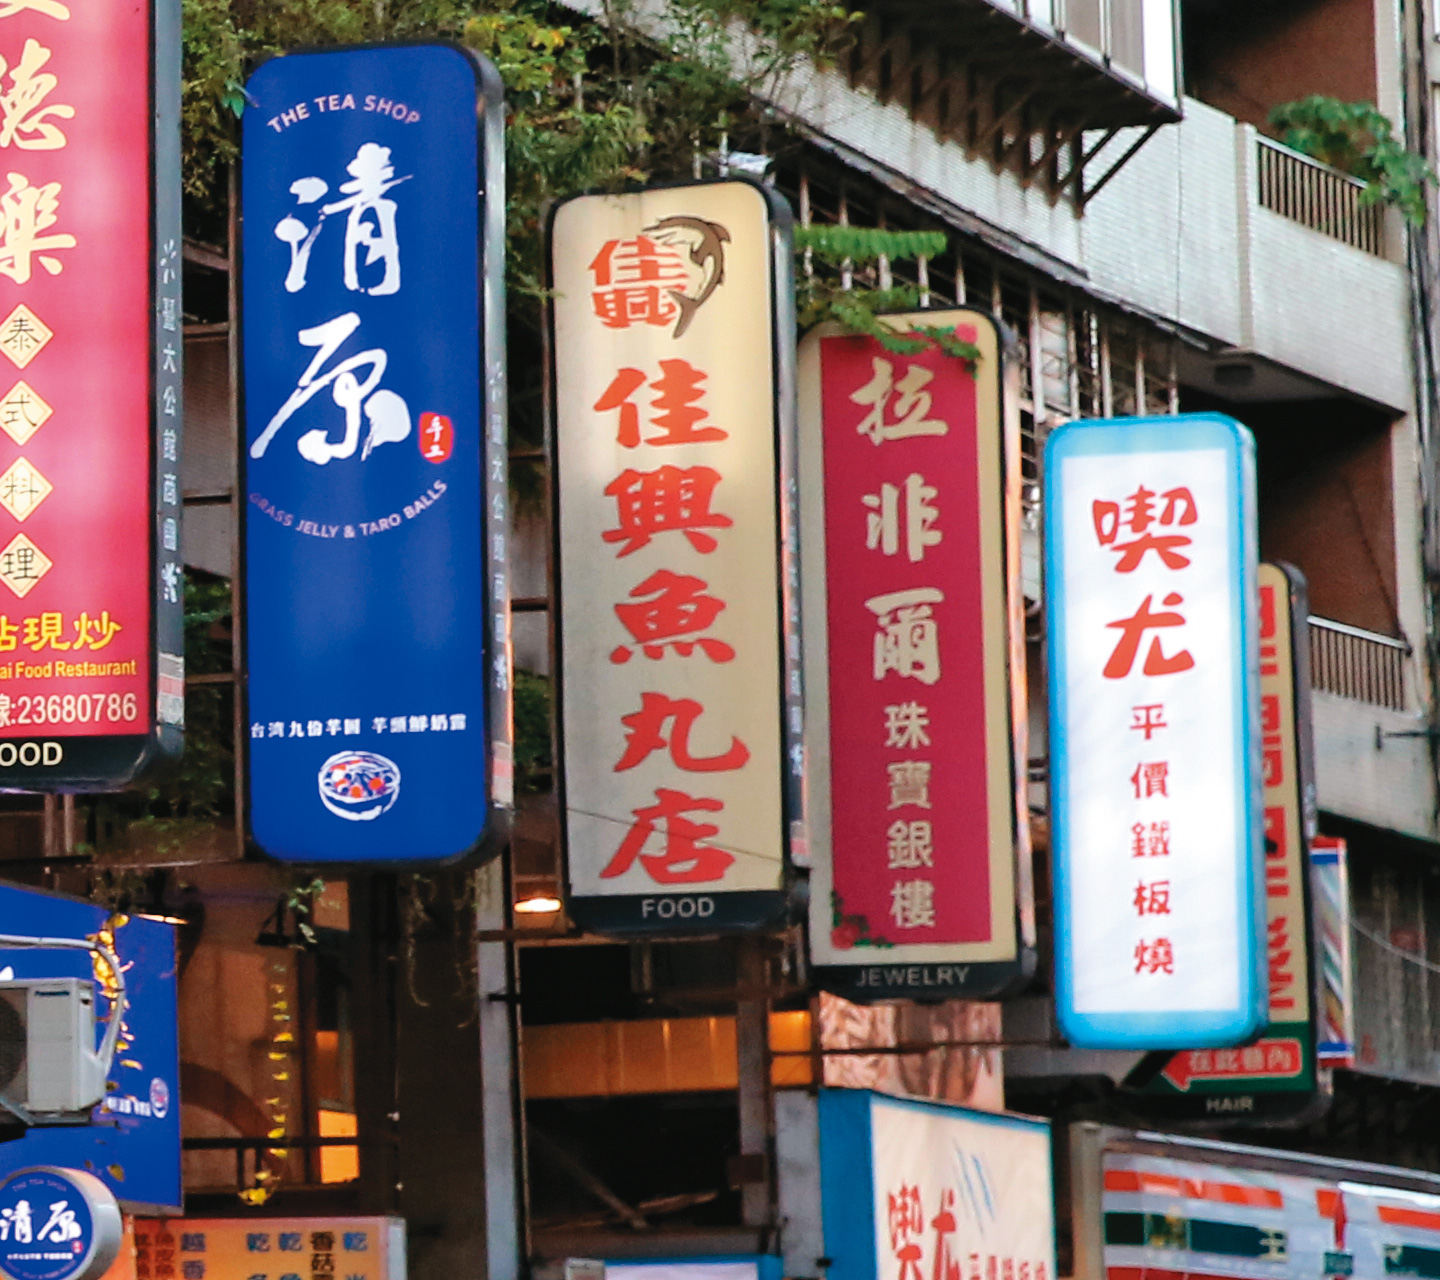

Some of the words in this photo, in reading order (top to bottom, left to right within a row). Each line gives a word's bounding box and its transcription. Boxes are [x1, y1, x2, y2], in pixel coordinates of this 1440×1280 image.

[267, 102, 311, 133] THE
[314, 94, 355, 112] TEA
[365, 95, 421, 124] SHOP
[250, 142, 414, 465] 清原
[2, 317, 41, 580] 泰式料理
[249, 493, 293, 527] GRASS
[296, 518, 338, 538] JELLY
[344, 525, 355, 539] &
[359, 517, 401, 537] TARO
[403, 480, 447, 518] BALLS
[15, 660, 51, 678] Food
[55, 658, 137, 677] Restaurant
[594, 358, 751, 885] 佳興魚丸店
[884, 701, 936, 929] 珠寶銀樓
[1130, 704, 1174, 975] 平價鐵板燒
[642, 897, 715, 920] FOOD
[856, 967, 970, 988] JEWELRY
